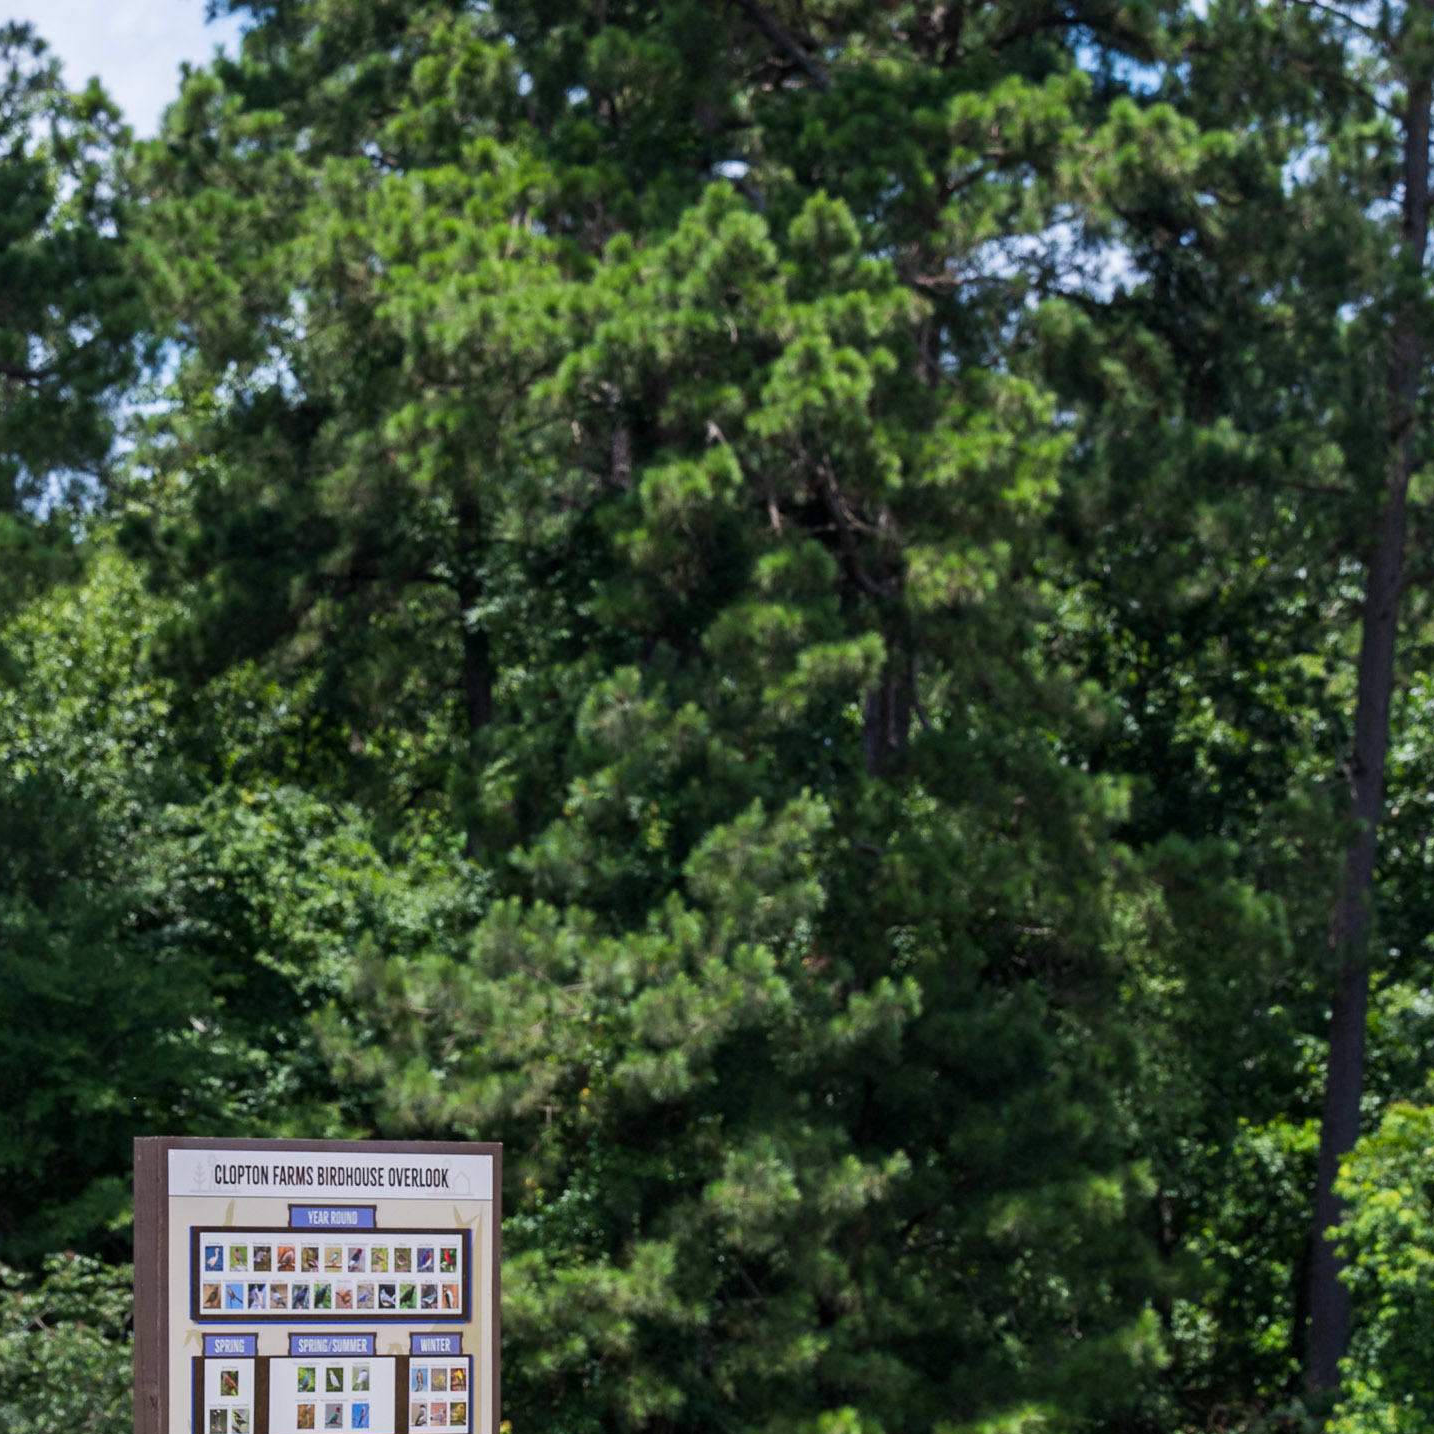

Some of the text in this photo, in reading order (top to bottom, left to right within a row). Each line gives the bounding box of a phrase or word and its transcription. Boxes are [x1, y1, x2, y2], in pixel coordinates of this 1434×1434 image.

[214, 1164, 449, 1188] CLOPTON FARMS BIRDHOUSE OVERLOOK
[307, 1210, 358, 1225] YEAR ROUND
[214, 1339, 245, 1354] SPRING
[298, 1338, 368, 1354] SPRING/SUMMER
[420, 1337, 451, 1353] WINTER
